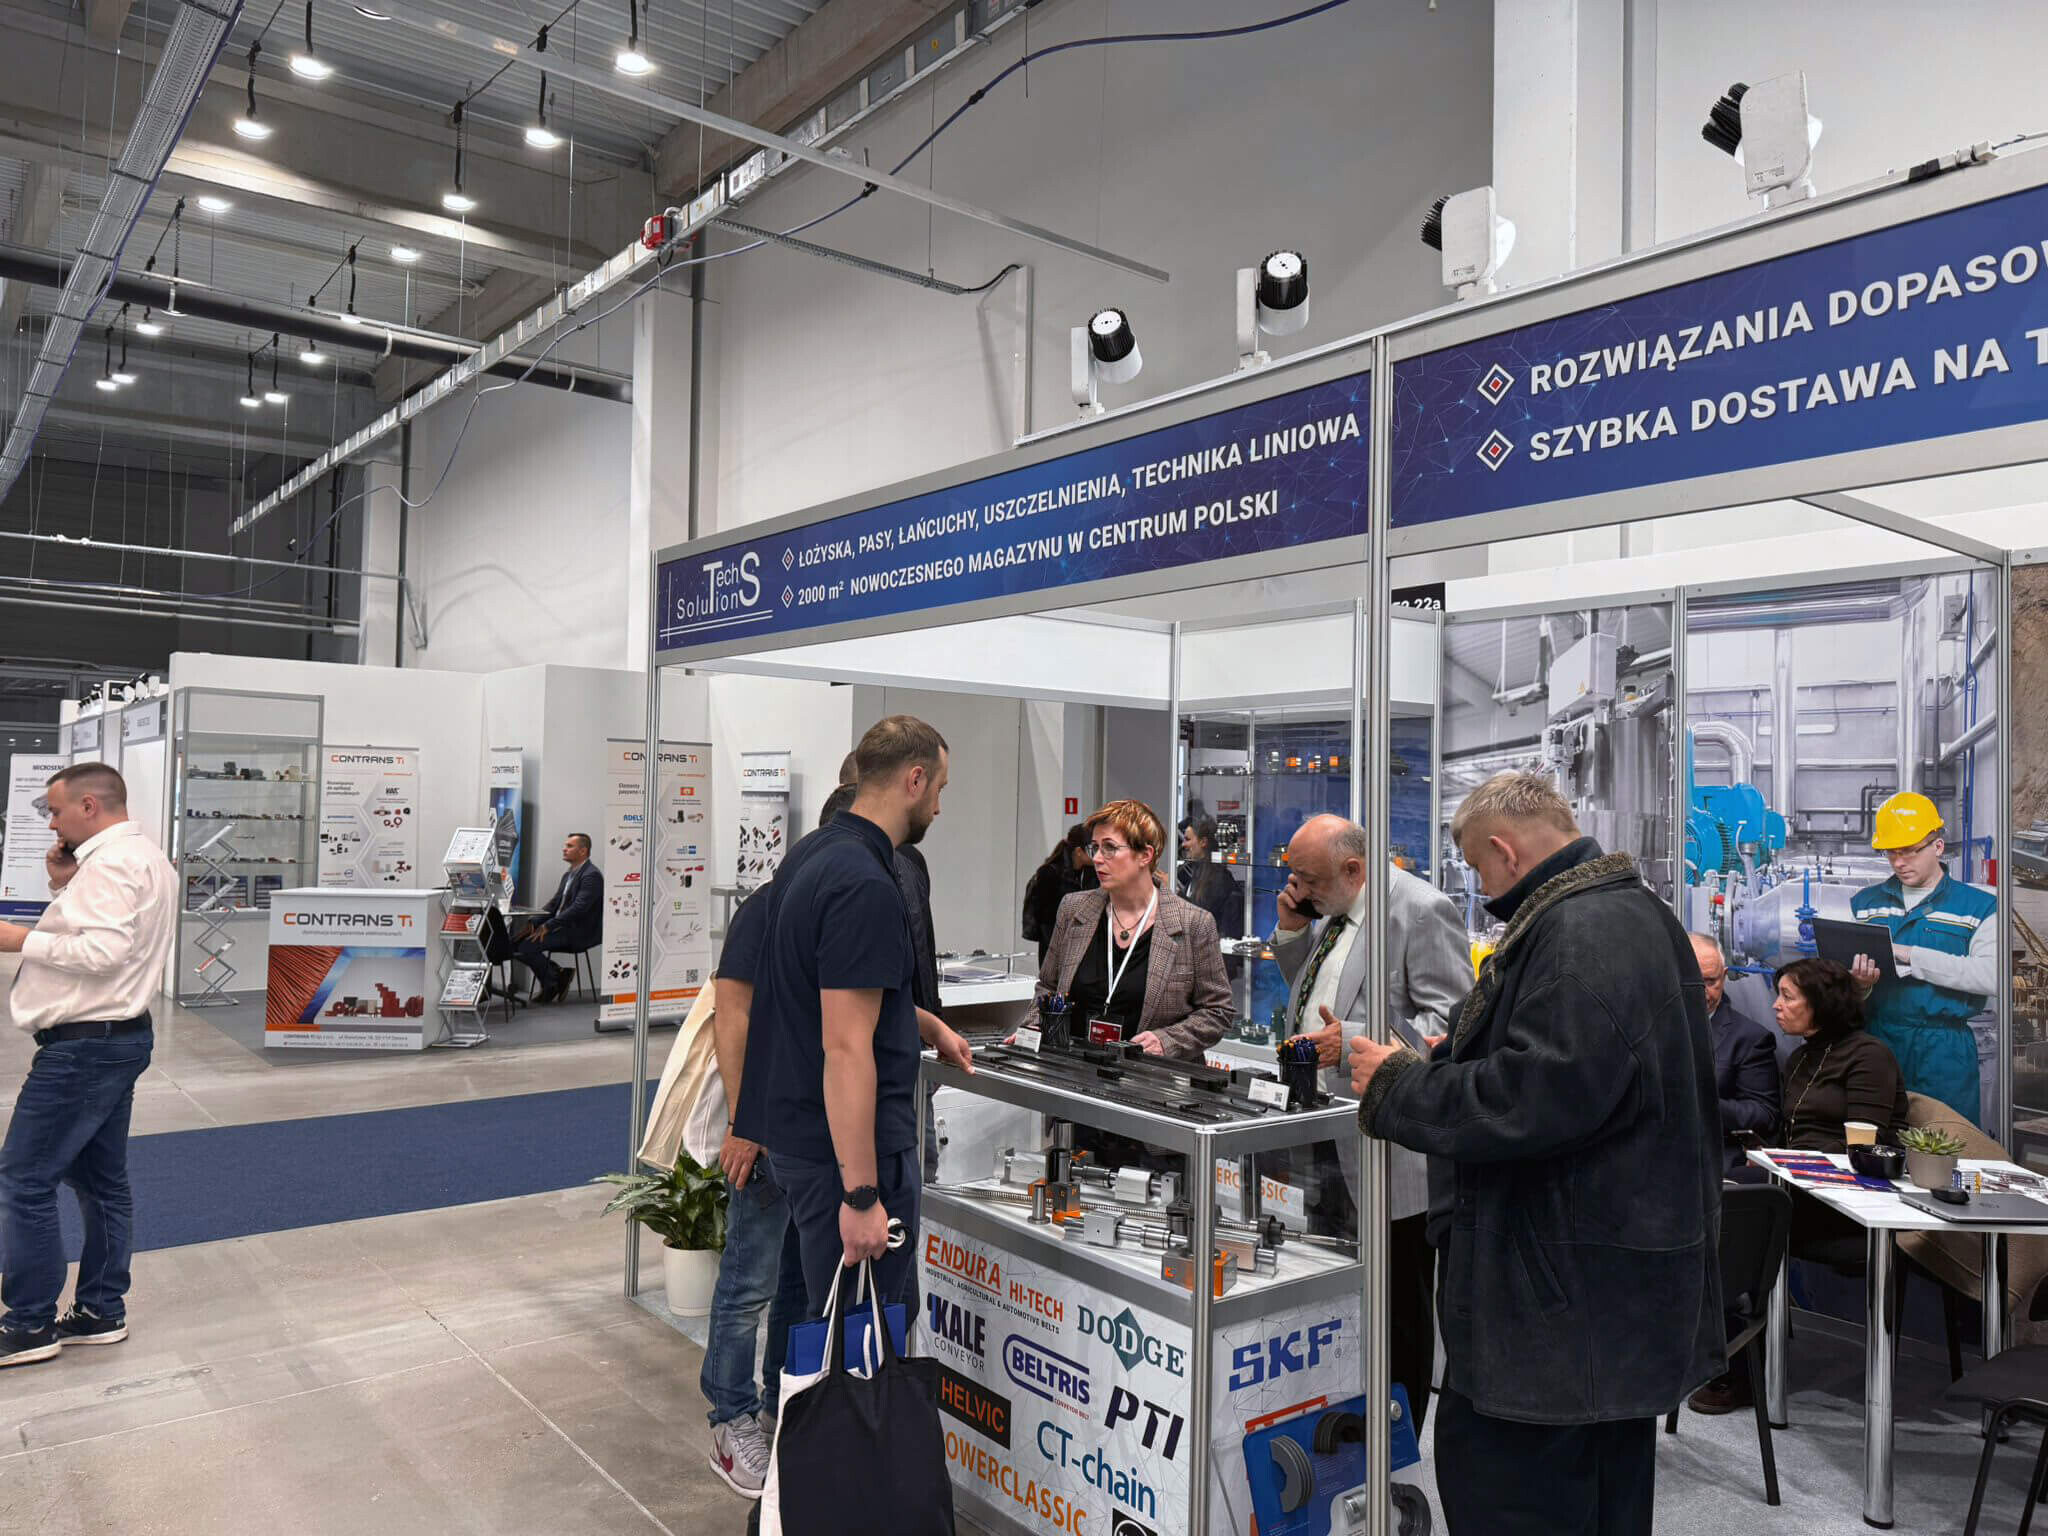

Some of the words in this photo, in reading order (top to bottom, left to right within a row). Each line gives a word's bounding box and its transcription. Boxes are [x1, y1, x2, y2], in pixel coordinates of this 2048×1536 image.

[1530, 299, 1814, 395] ROZWIĄZANIA
[1828, 239, 2048, 326] DOPASO
[1529, 406, 1679, 461] SZYBKA
[1691, 356, 1917, 432] DOSTAWA
[1934, 337, 2010, 385] NA
[798, 540, 856, 568] ŁOŻYSKA,
[859, 529, 894, 554] PASY,
[898, 509, 979, 545] ŁAŃCUCHY,
[984, 473, 1126, 525] USZCZELNIENIA,
[1132, 443, 1243, 490] TECHNIKA
[1249, 413, 1361, 463] LINIOWA
[798, 585, 826, 605] 2000
[850, 557, 964, 596] NOWOCZESNEGO
[968, 535, 1063, 574] MAGAZYNU
[1067, 531, 1084, 554] W
[1088, 509, 1188, 550] CENTRUM
[1194, 489, 1279, 530] POLSKI
[331, 754, 394, 764] CONTRANS
[623, 752, 687, 763] CONRANS
[283, 912, 394, 927] CONTRANS
[925, 1234, 1001, 1290] ENDURA
[1009, 1279, 1065, 1322] HI-TECH
[957, 1281, 997, 1306] AGRICULTURAL
[1002, 1304, 1040, 1326] AUTOMOTIVE
[1041, 1319, 1060, 1335] BELTS
[930, 1293, 986, 1358] KALE
[934, 1336, 985, 1372] CONVEYOR
[1077, 1304, 1185, 1378] DODGE
[1229, 1318, 1342, 1392] SKF
[941, 1376, 1005, 1434] HELVIC
[1012, 1345, 1090, 1405] BELTRIS
[1104, 1385, 1185, 1461] PTI
[945, 1430, 1087, 1536] OWERCLASSIC
[1036, 1420, 1156, 1519] CT-chain
